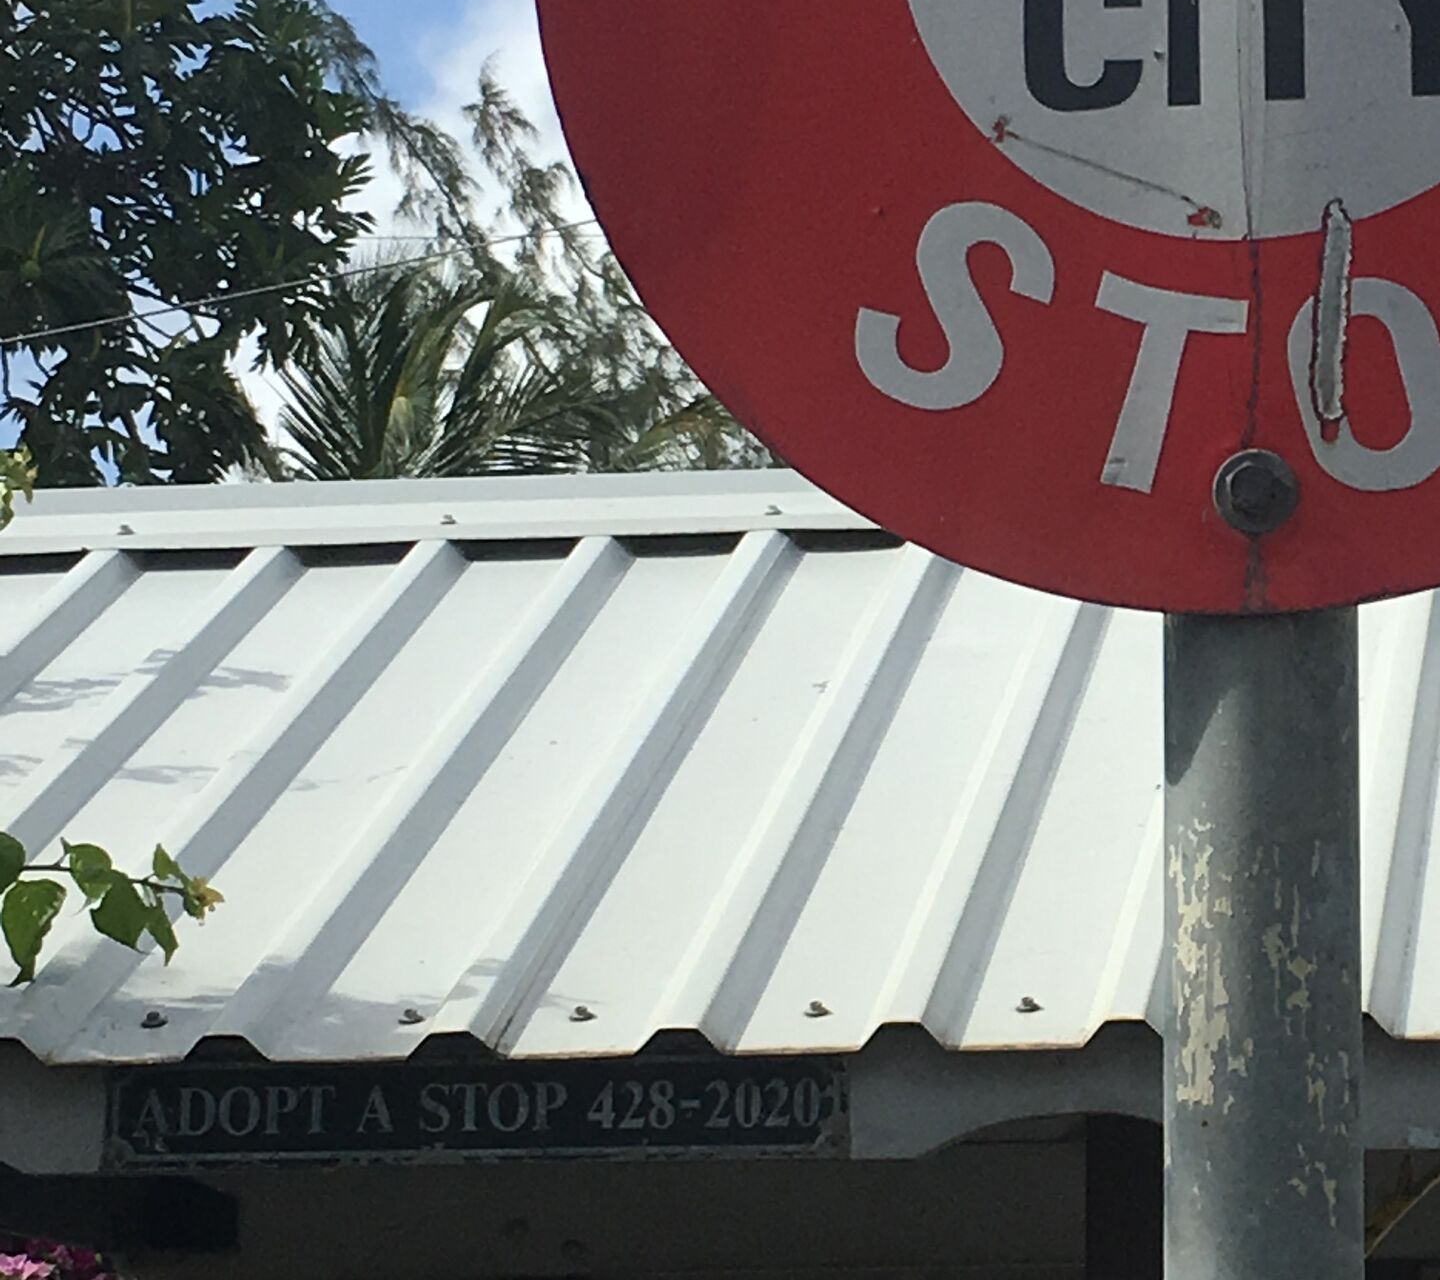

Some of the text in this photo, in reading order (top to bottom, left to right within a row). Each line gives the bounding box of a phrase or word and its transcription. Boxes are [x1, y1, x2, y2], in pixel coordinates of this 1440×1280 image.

[137, 1080, 821, 1137] ADOPT A STOP 428-2020
